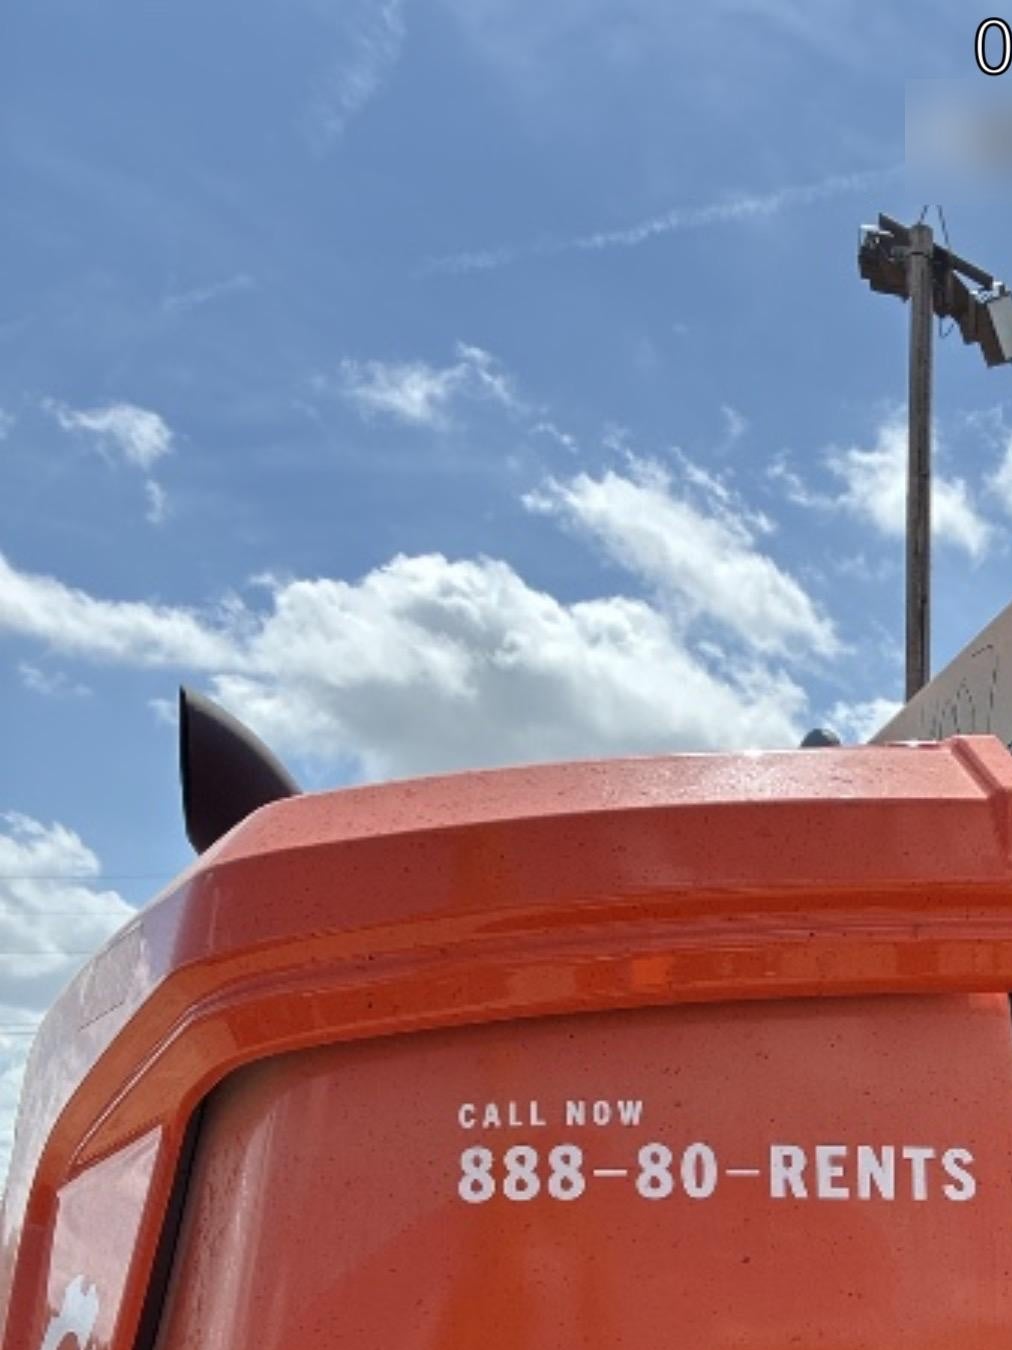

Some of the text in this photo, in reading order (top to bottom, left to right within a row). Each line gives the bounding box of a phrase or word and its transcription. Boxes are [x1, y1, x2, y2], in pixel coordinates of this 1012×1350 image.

[457, 1099, 644, 1129] CALL NOW
[457, 1142, 978, 1203] 888-80-RENTS
